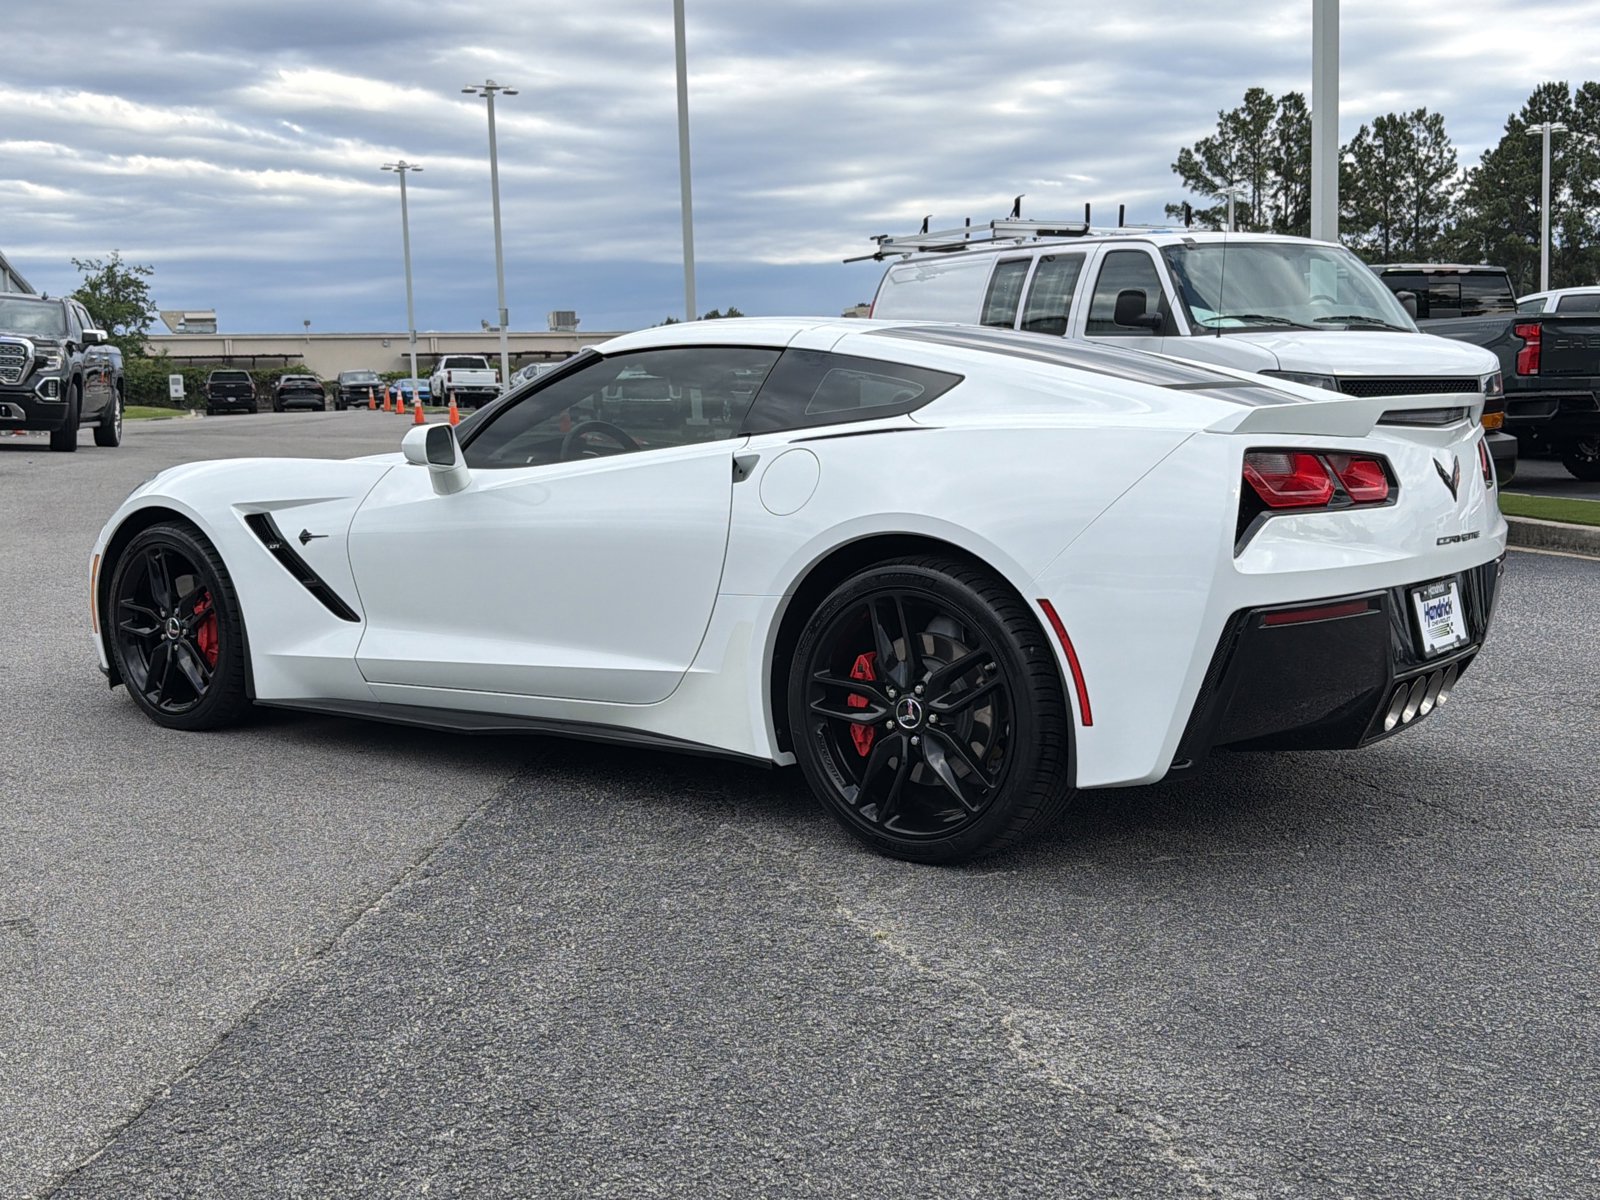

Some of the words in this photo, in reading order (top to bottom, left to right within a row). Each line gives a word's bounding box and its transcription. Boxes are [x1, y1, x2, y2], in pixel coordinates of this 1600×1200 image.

[1436, 531, 1480, 546] CORVETTE
[1423, 597, 1453, 628] Hendrick
[1431, 616, 1451, 627] CHEVROLET
